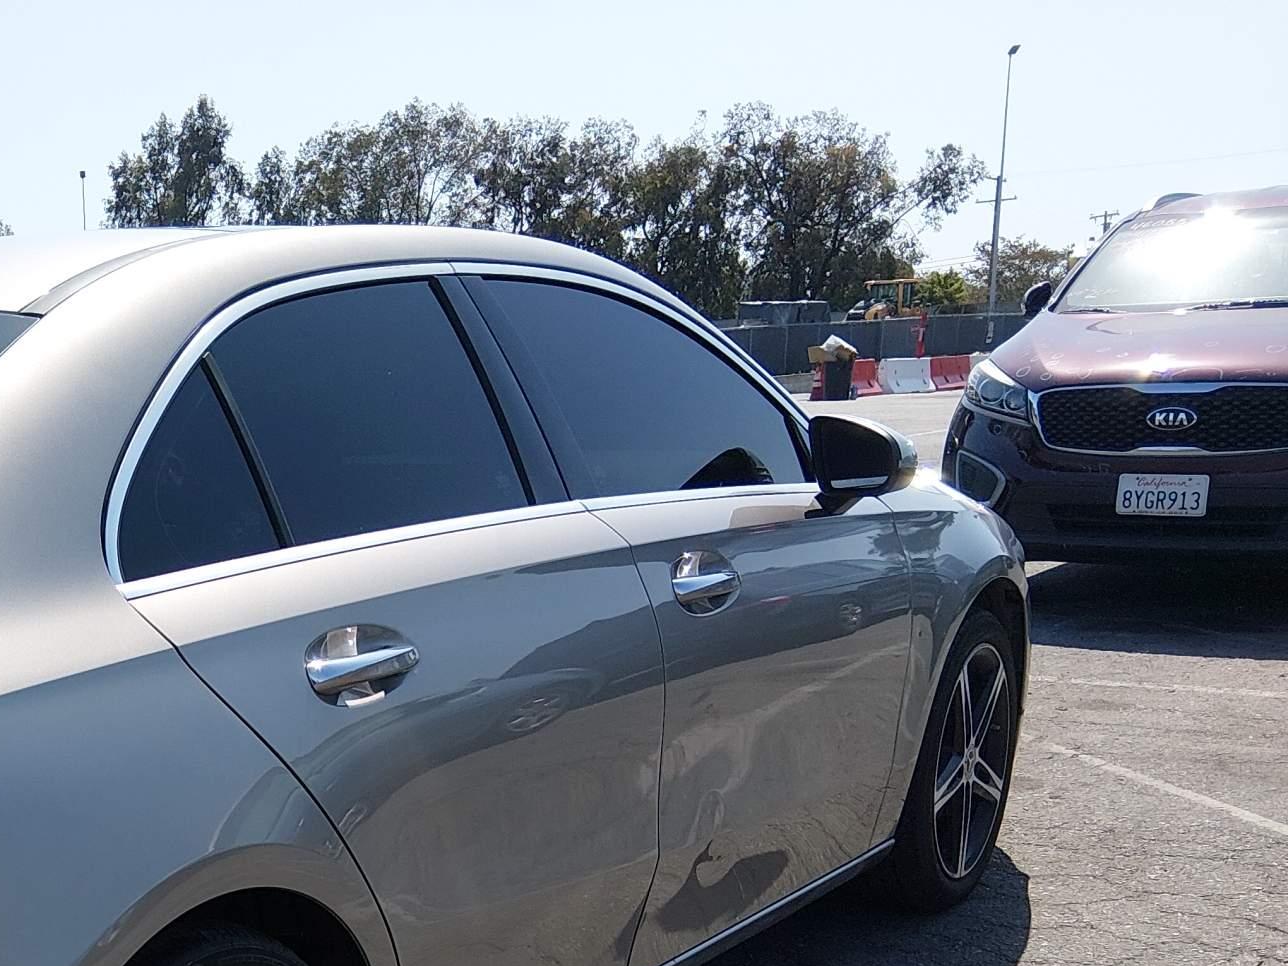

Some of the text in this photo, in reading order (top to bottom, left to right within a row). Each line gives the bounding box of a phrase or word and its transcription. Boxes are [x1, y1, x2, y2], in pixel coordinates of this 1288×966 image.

[1154, 412, 1188, 426] KIA
[1137, 477, 1188, 489] California
[1122, 490, 1201, 510] 8YGR913
